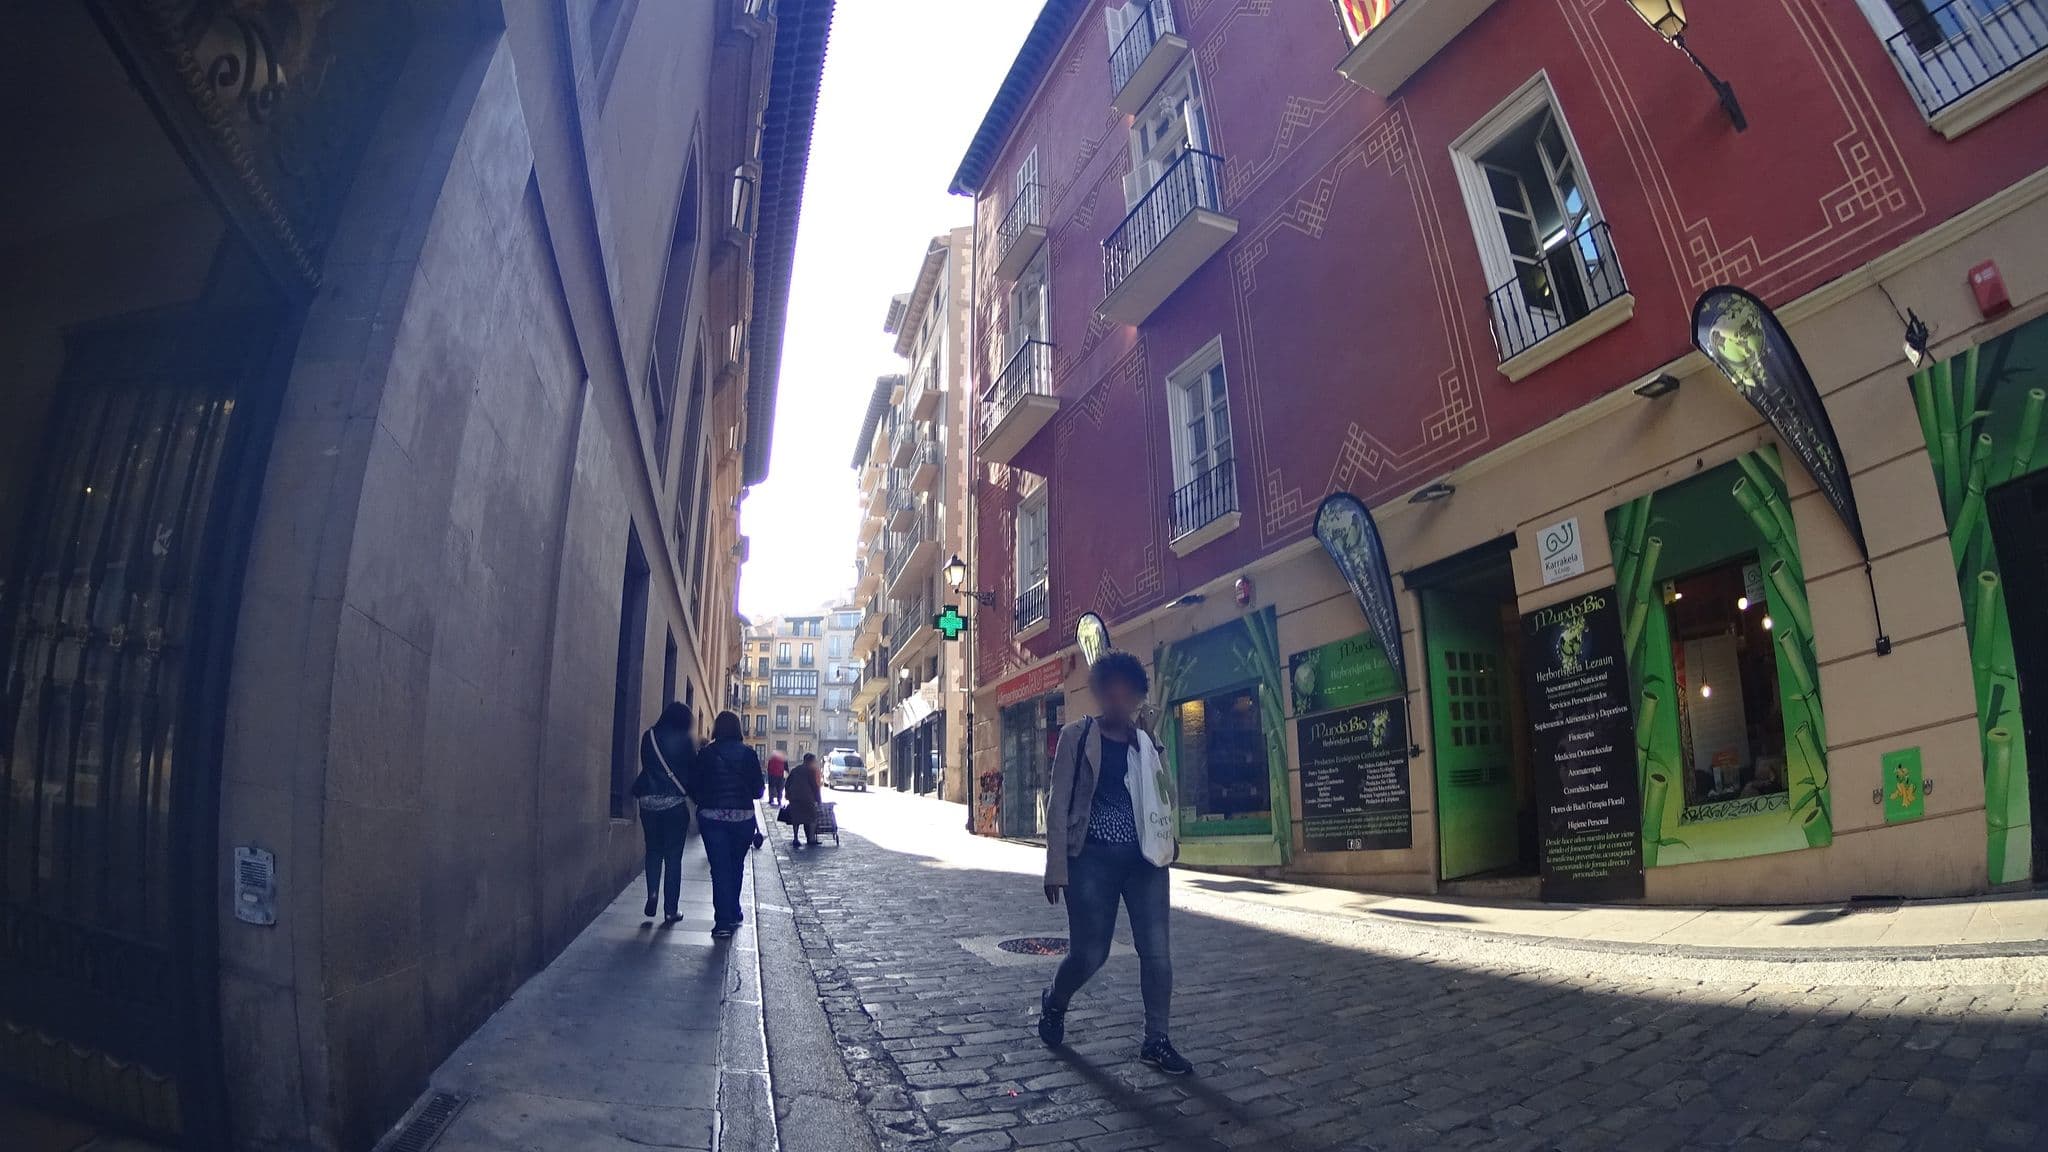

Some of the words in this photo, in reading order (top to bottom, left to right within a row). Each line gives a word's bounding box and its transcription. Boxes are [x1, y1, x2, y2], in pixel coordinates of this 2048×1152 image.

[1812, 462, 1845, 510] Lezaun
[1546, 554, 1578, 571] Karrakela
[1534, 602, 1581, 632] Mundo
[1581, 595, 1606, 614] Bio
[1585, 655, 1614, 671] Lezaun
[1545, 681, 1580, 694] Asesoramiento
[1580, 672, 1608, 685] Nutricional
[1549, 700, 1571, 711] Servicios
[1571, 691, 1607, 706] Personalizados
[1534, 718, 1564, 732] Suplementos
[1565, 713, 1596, 725] Alimenticios
[1600, 705, 1628, 719] Deportivos
[1568, 730, 1595, 742] Fitoterapia
[1554, 751, 1577, 762] Medicina
[1577, 744, 1614, 758] Ortomolecular
[1568, 765, 1602, 777] Aromaterapia
[1590, 780, 1609, 791] Natural
[1550, 805, 1565, 815] Flores
[1573, 802, 1586, 811] Bach
[1587, 800, 1607, 811] (Terapia
[1608, 797, 1625, 807] Floral)
[1567, 821, 1587, 830] Higiene
[1587, 817, 1609, 827] Personal
